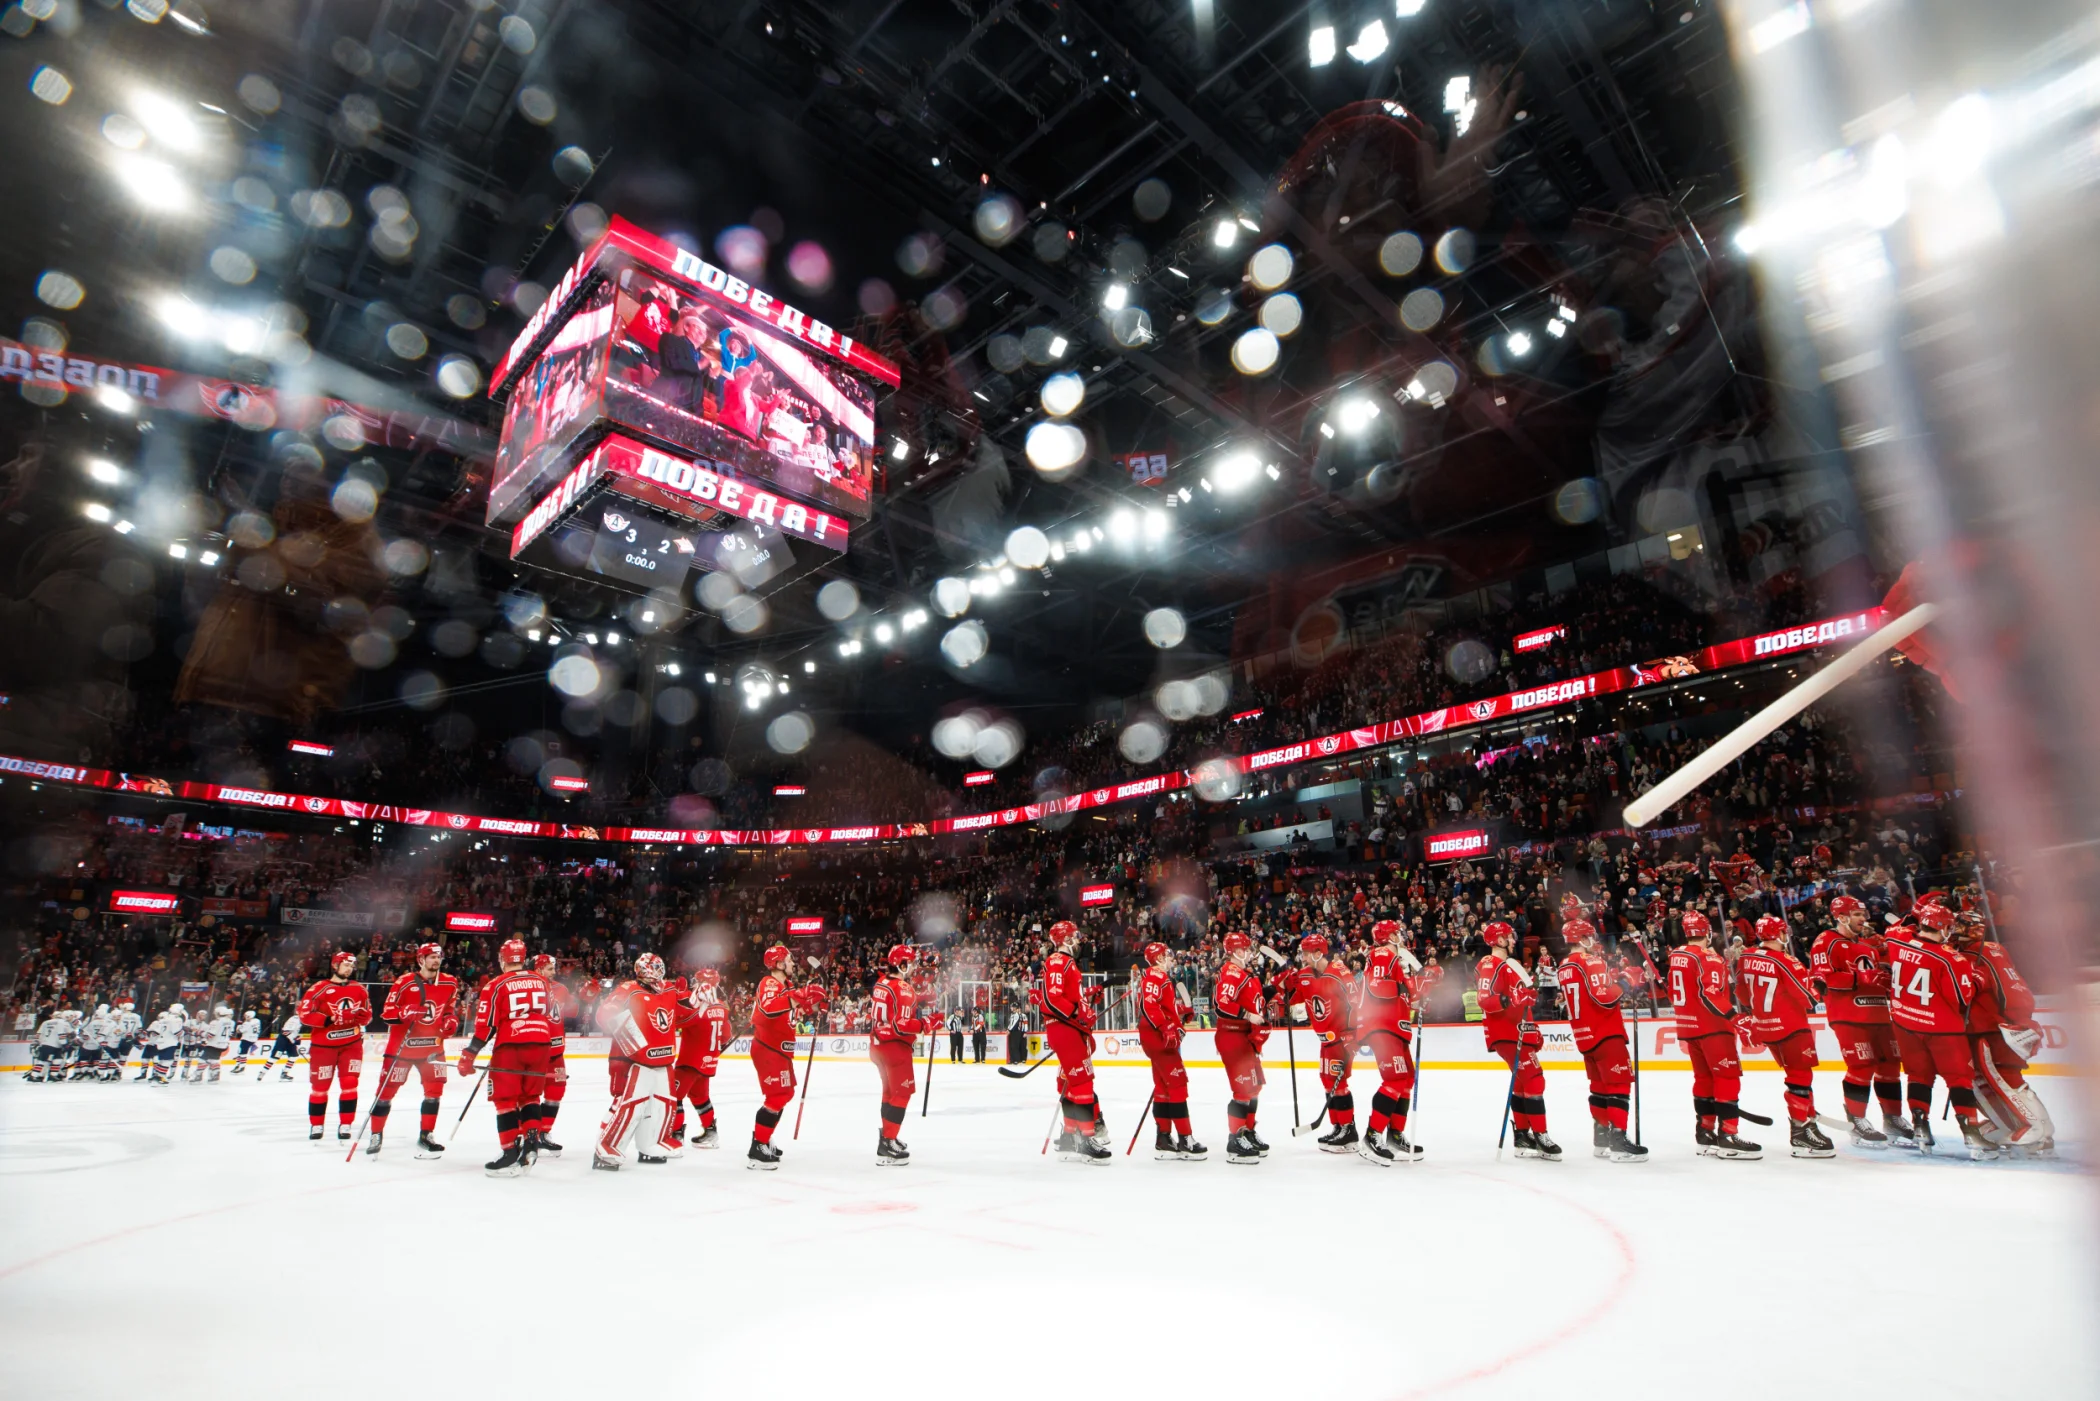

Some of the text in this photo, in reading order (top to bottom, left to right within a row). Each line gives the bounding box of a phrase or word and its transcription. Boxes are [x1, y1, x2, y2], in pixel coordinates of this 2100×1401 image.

[625, 528, 671, 554] 3 2
[737, 525, 765, 550] 3 2
[625, 553, 656, 570] 0:00.0
[1082, 888, 1113, 902] ПОБЕДА
[790, 921, 821, 931] ПОБЕДА
[1813, 952, 1827, 965] 88
[1899, 949, 1923, 965] DIETZ
[1373, 965, 1384, 977] 81
[1752, 959, 1775, 975] COSTA
[1050, 972, 1062, 985] 76
[1590, 973, 1607, 987] 97
[1711, 972, 1720, 984] 9
[1891, 961, 1935, 1006] 44
[1145, 981, 1159, 996] 58
[1672, 970, 1687, 1007] 9
[1744, 973, 1779, 1013] 77
[509, 991, 546, 1019] 55
[901, 1005, 911, 1019] 10
[330, 1030, 354, 1038] Winline
